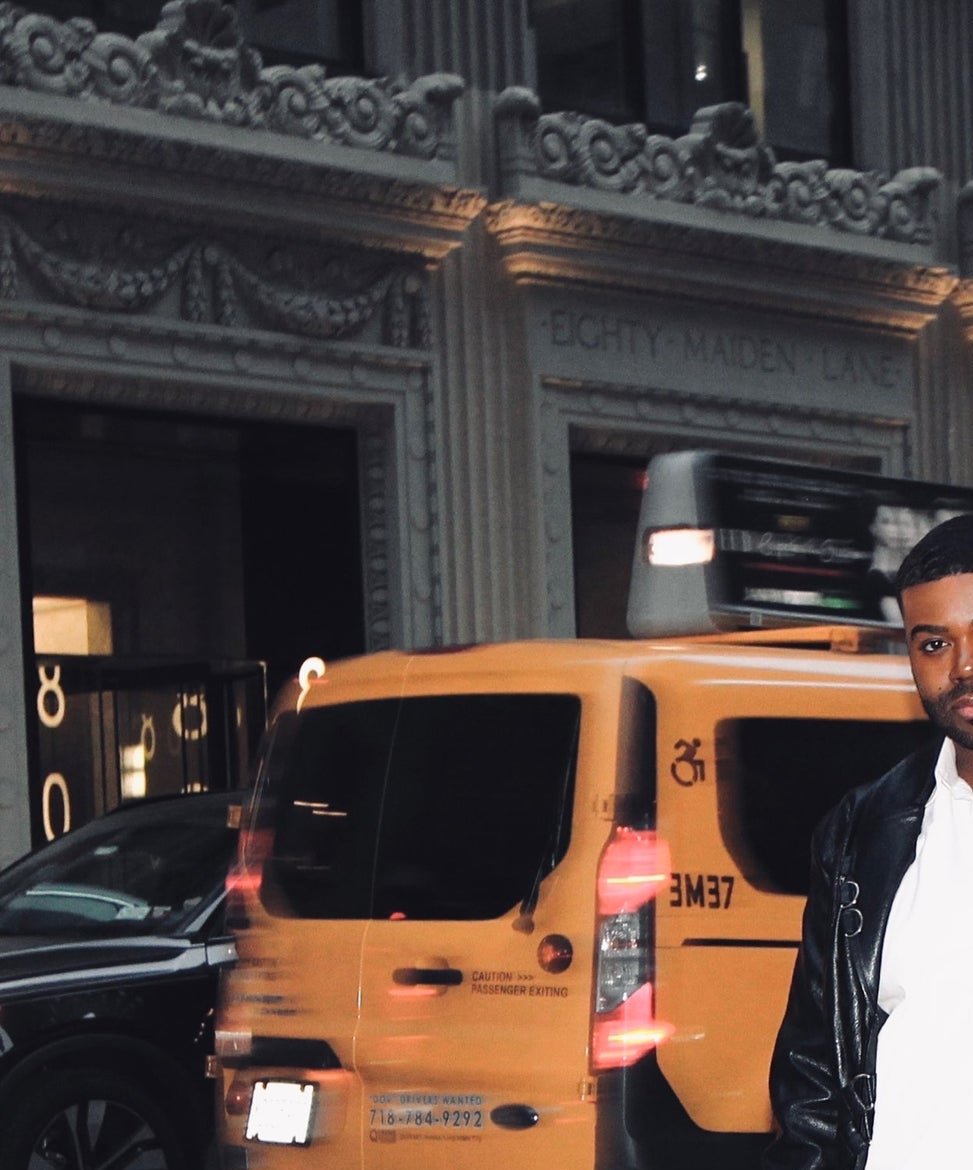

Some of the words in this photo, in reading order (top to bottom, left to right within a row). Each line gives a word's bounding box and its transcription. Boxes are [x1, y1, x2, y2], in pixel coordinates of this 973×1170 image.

[550, 309, 663, 359] EIGHTY
[683, 328, 797, 376] MAIDEN
[822, 346, 896, 388] LANE
[669, 872, 735, 909] 3M37
[472, 970, 513, 982] CAUTION
[471, 984, 527, 996] PASSENGER
[529, 986, 569, 998] EXITING
[399, 1095, 438, 1106] DRIVERS
[443, 1096, 482, 1106] WANTED
[369, 1109, 482, 1128] 718-784-9292
